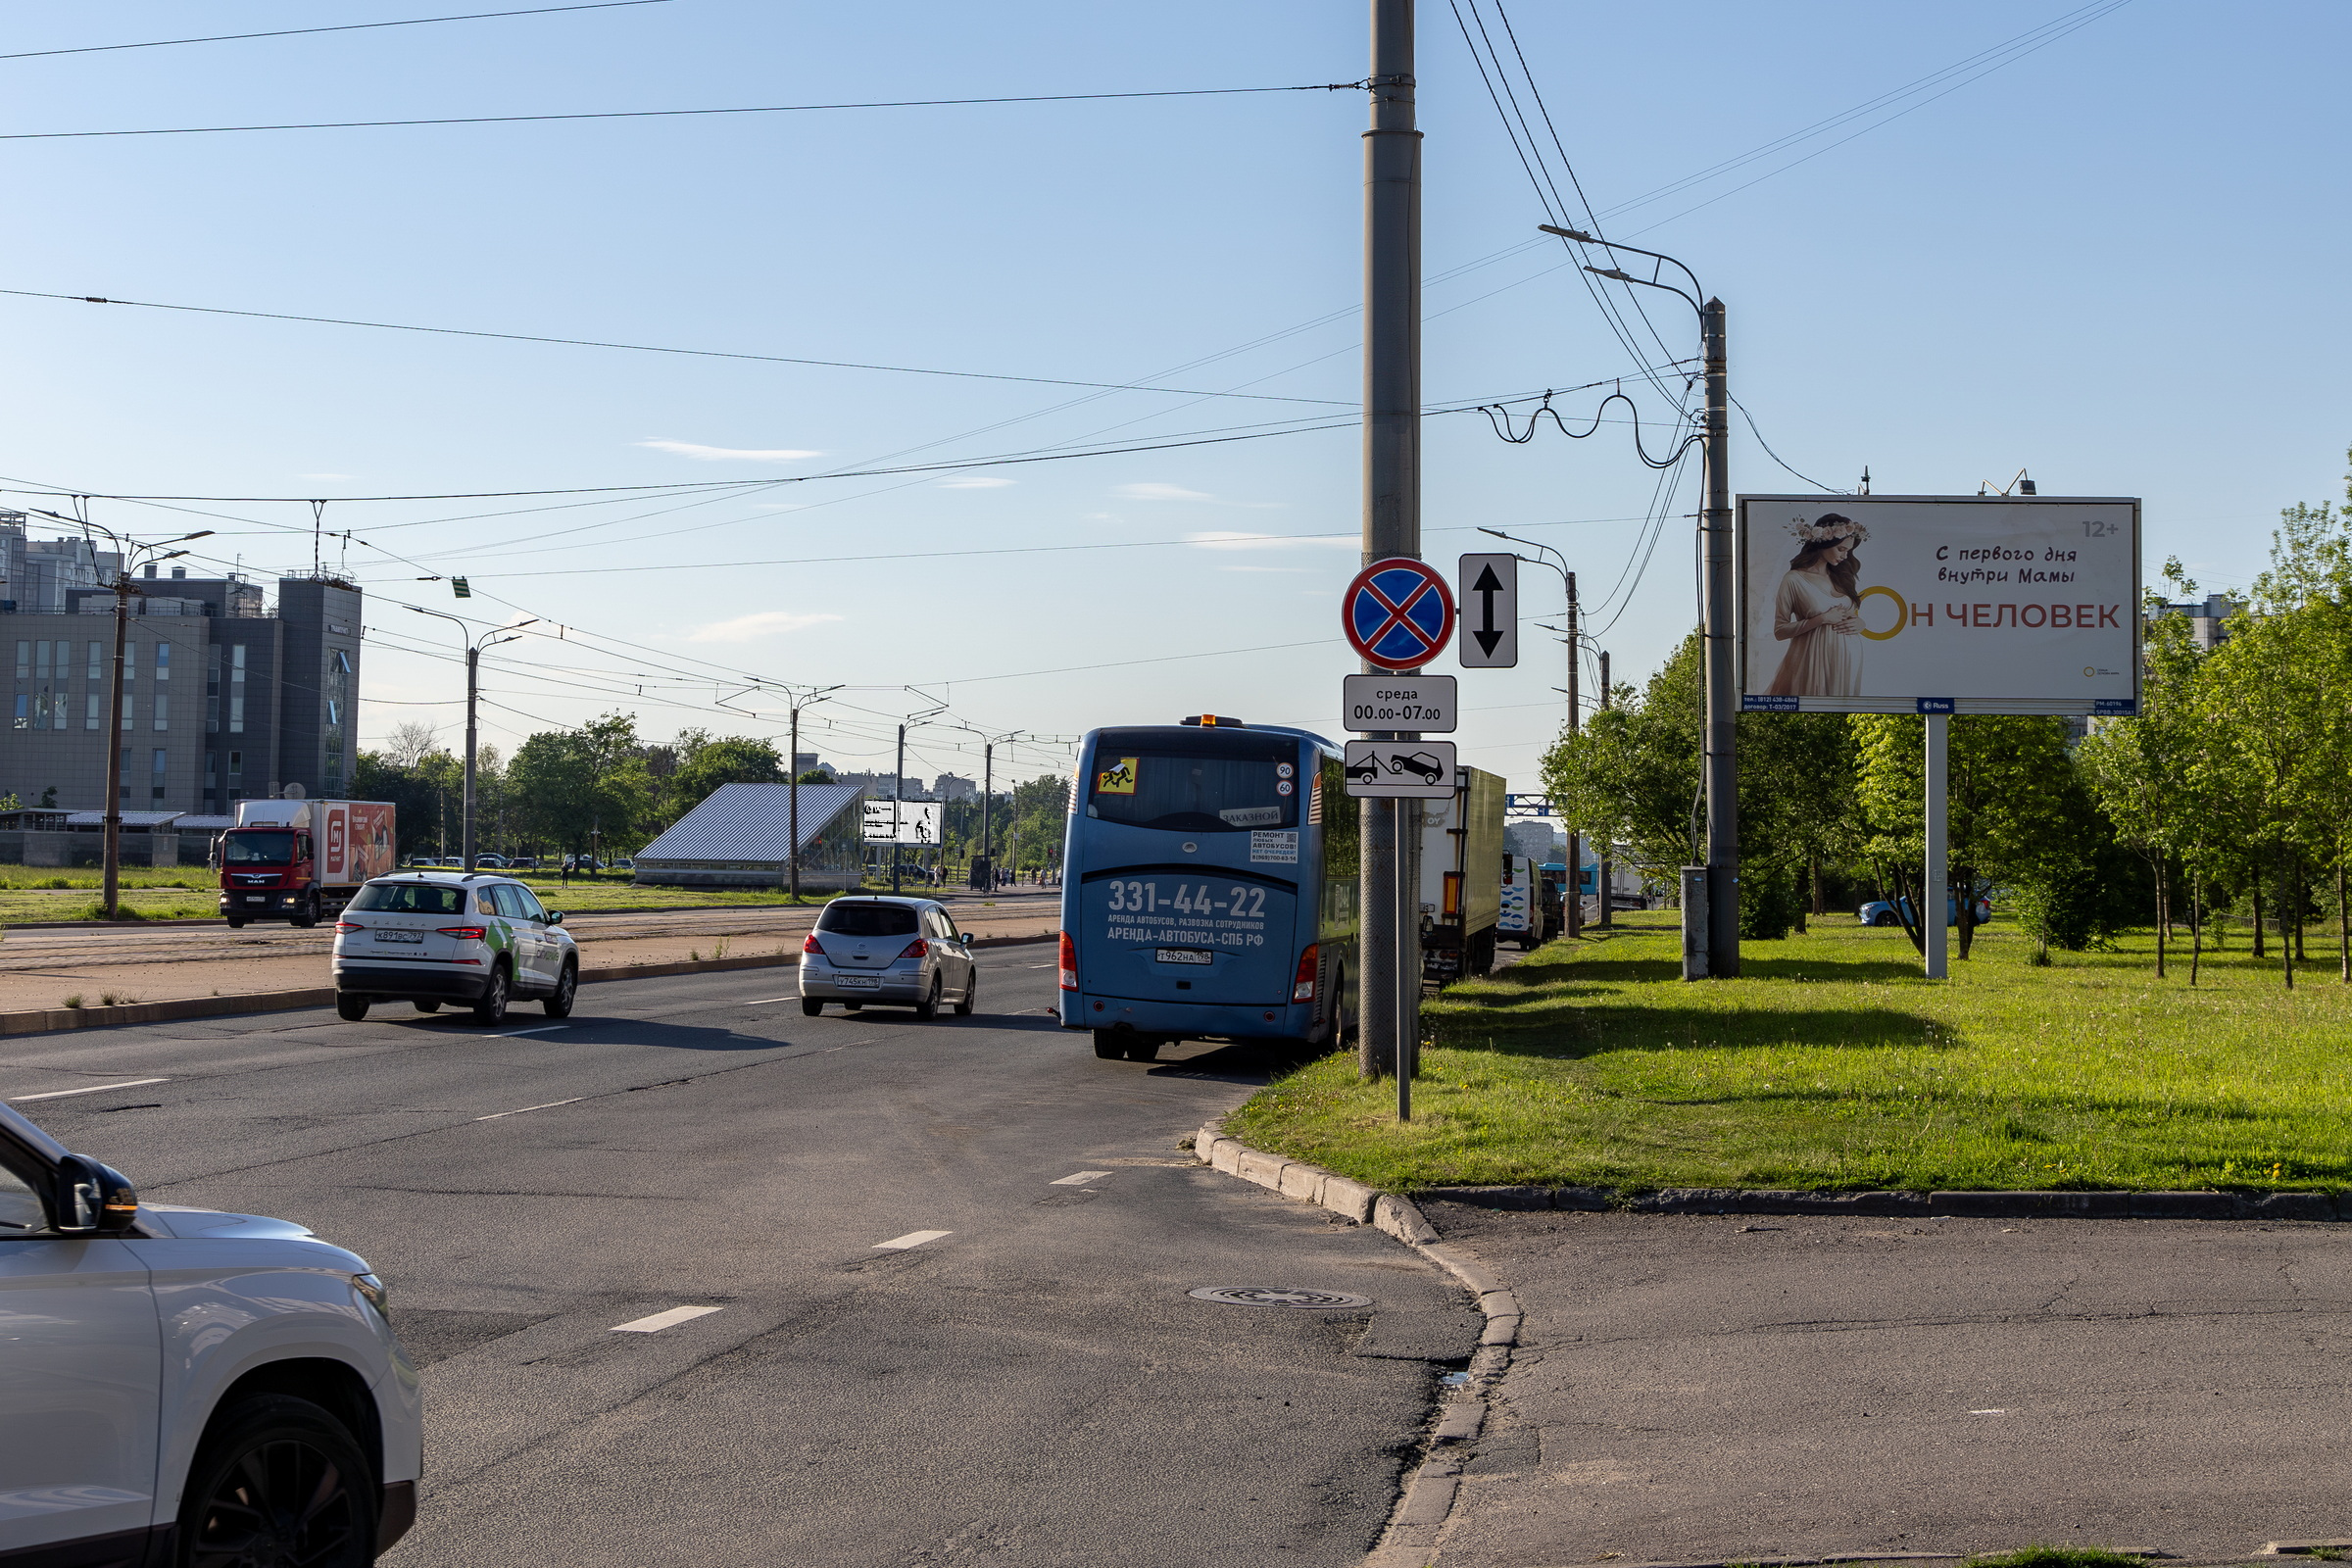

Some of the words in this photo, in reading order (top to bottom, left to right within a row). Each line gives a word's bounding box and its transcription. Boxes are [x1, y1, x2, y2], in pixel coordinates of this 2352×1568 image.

[2082, 520, 2119, 538] 12+
[1936, 545, 1949, 562] С
[1959, 545, 2034, 564] первого
[2044, 546, 2078, 563] дня
[1937, 566, 2009, 585] внутри
[2018, 567, 2076, 584] Мамы
[1946, 603, 2122, 629] ЧЕЛОВЕК
[1376, 690, 1418, 702] среда
[1353, 705, 1441, 720] 00.00-07.00
[1279, 766, 1291, 775] 90
[1223, 809, 1279, 822] ЗАКАЗНОЙ
[1108, 881, 1266, 918] 331-44-22
[1107, 914, 1135, 924] АРЕНДА
[1137, 916, 1177, 927] АВТОБУСОВ,
[1178, 917, 1214, 928] РАЗВОЗКА
[1215, 919, 1265, 930] СОТРУДНИКОВ
